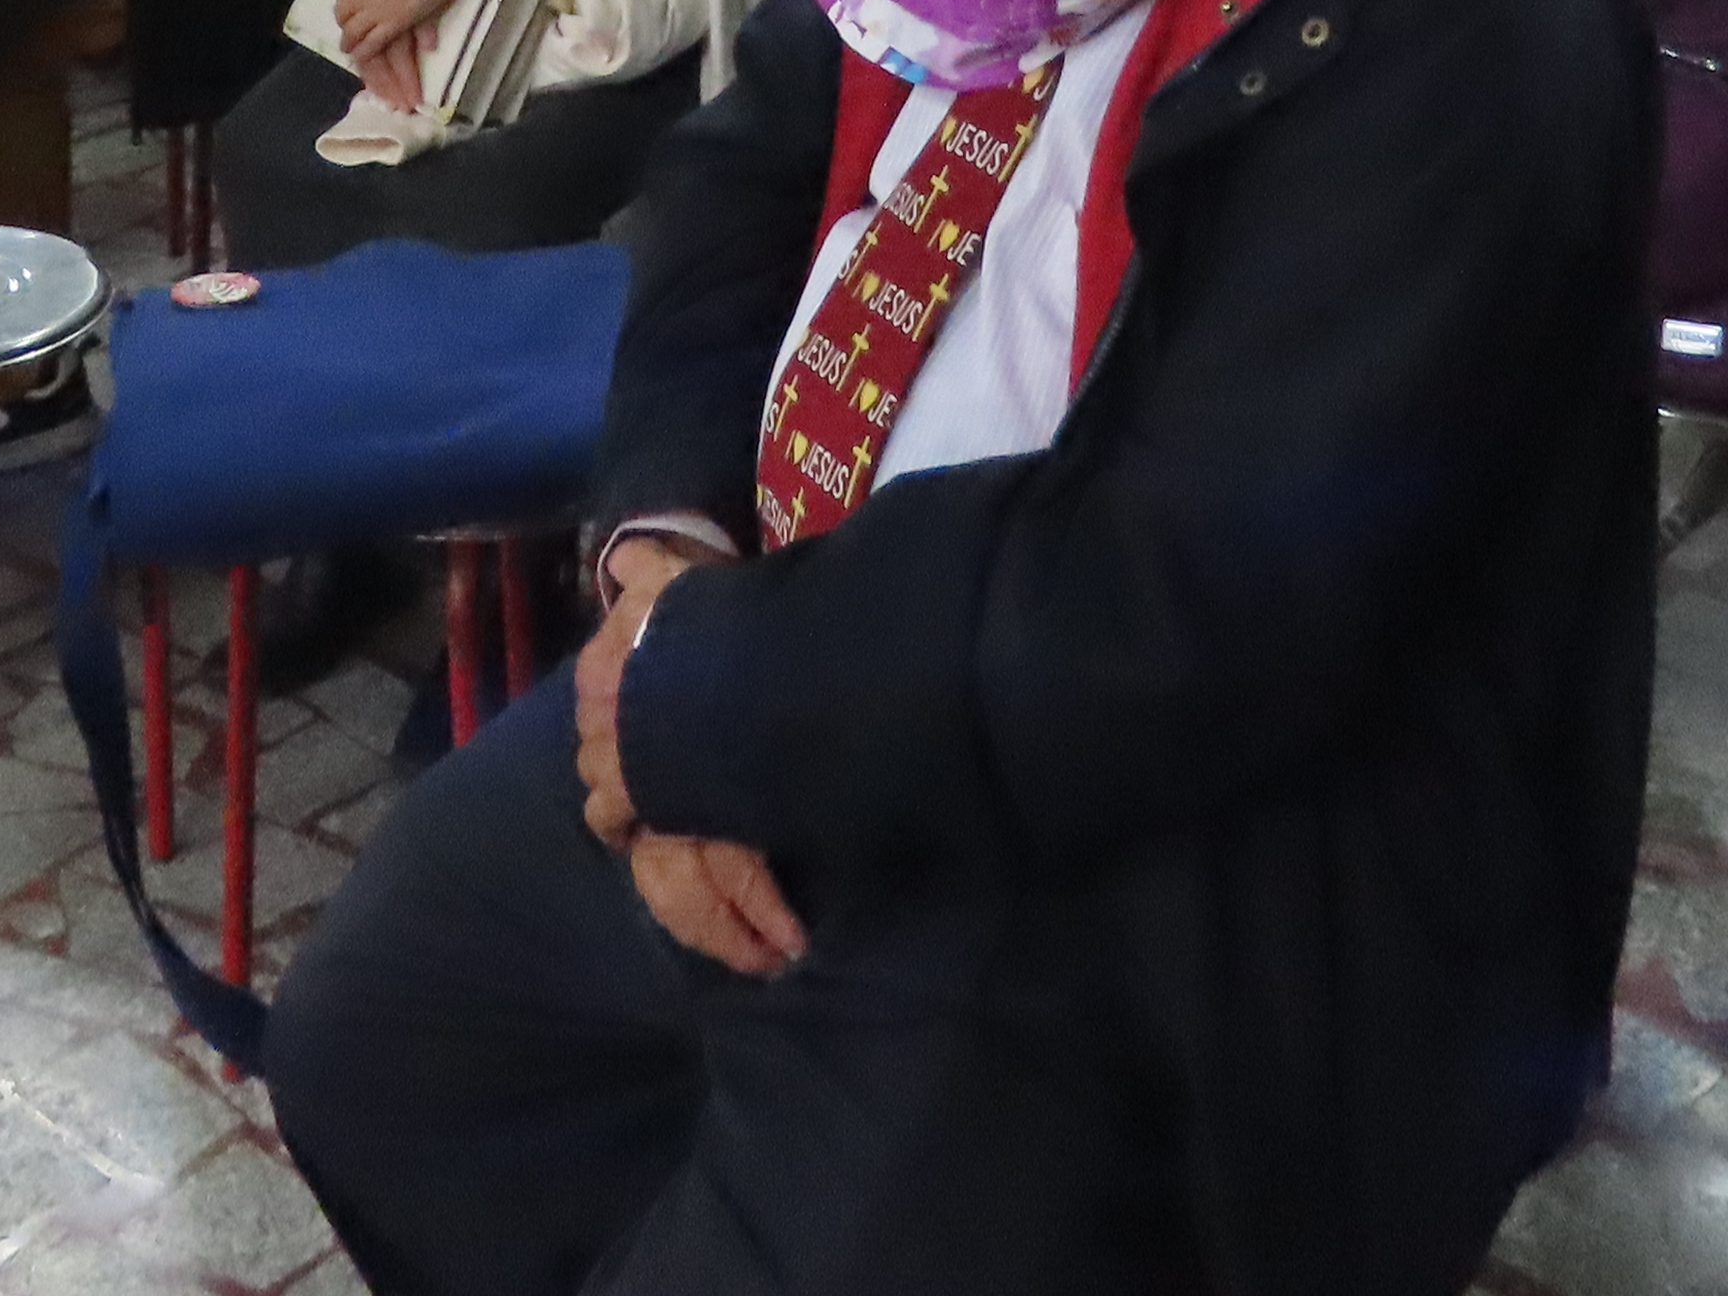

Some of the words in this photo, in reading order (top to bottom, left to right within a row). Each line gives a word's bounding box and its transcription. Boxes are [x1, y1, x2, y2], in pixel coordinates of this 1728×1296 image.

[946, 121, 1009, 176] JESUS
[869, 279, 923, 334] JESUS
[797, 333, 847, 385] JESUS
[801, 442, 849, 499] JESUS
